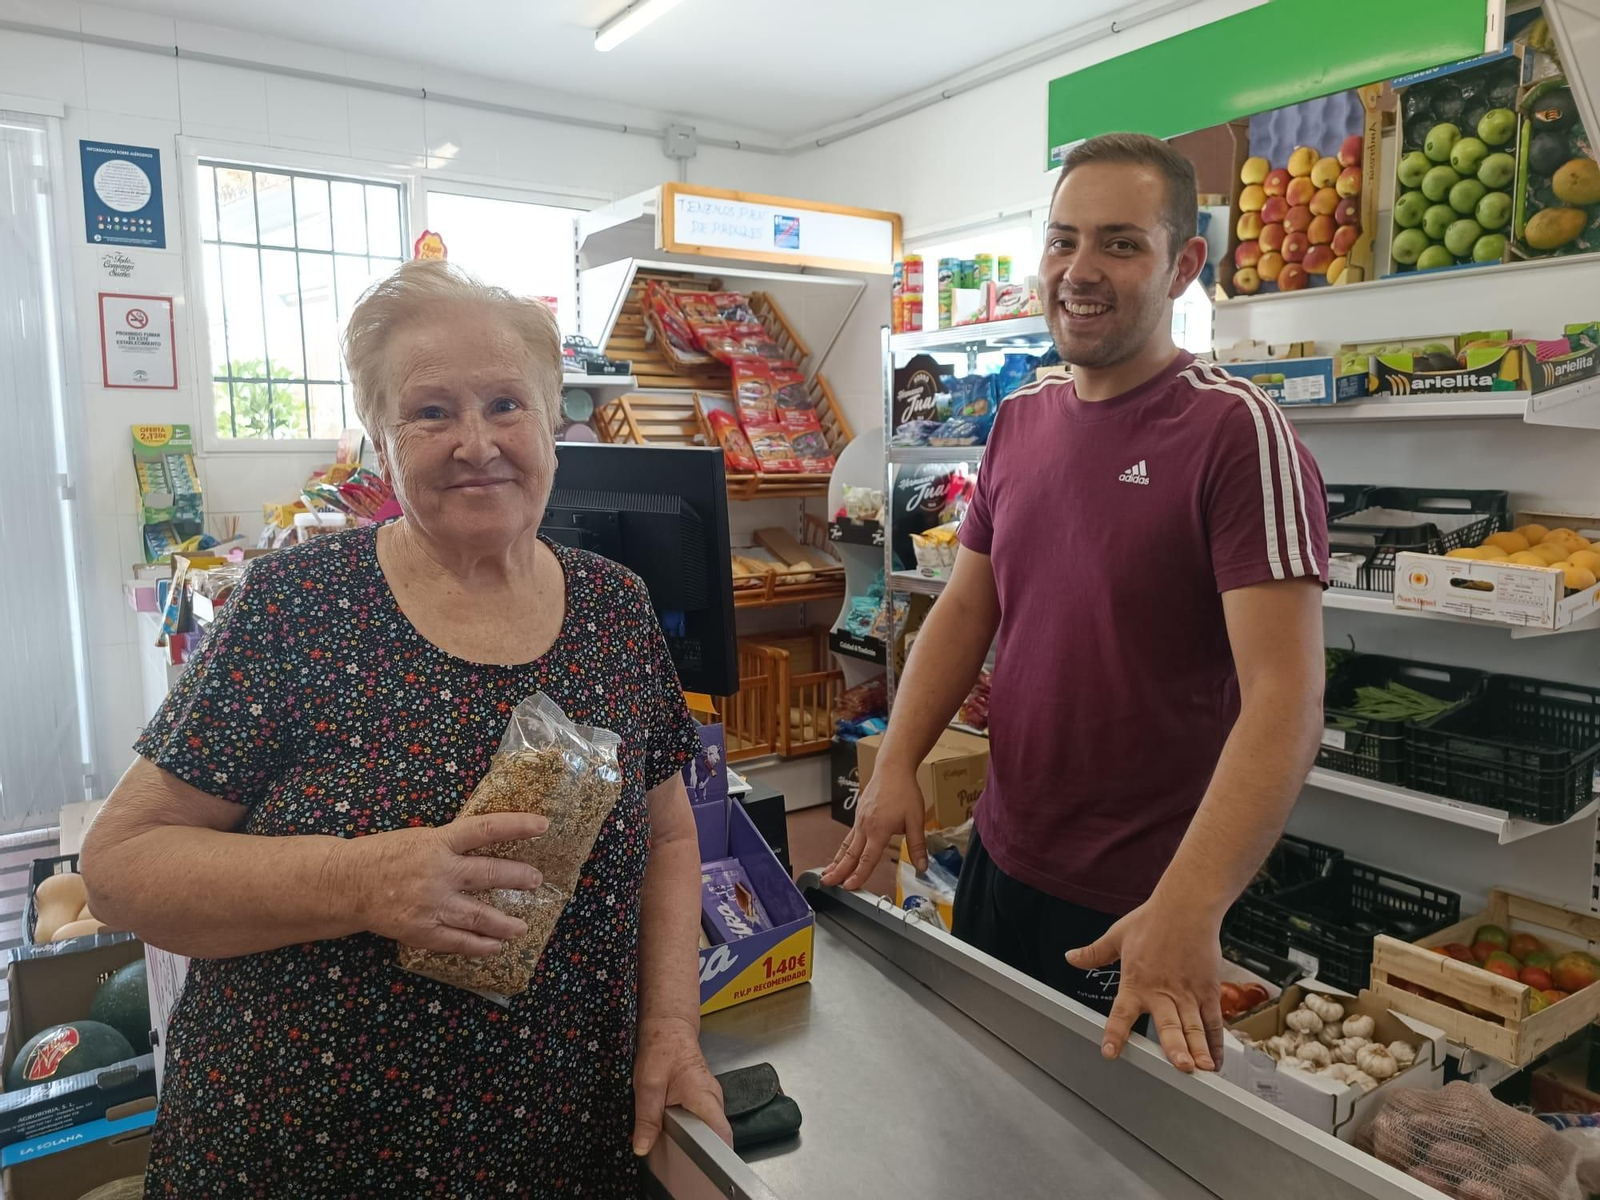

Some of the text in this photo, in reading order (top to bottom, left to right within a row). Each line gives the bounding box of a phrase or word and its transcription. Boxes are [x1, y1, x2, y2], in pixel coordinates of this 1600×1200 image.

[86, 146, 116, 154] INFORMACIÓN
[1555, 356, 1594, 377] arielita
[1411, 374, 1493, 390] arielita
[1119, 473, 1150, 485] adidas
[762, 951, 806, 979] 1,40€
[753, 969, 807, 993] RECOMENDADO
[1077, 990, 1099, 1000] FUTURE
[20, 1133, 84, 1156] LA SOLANA
